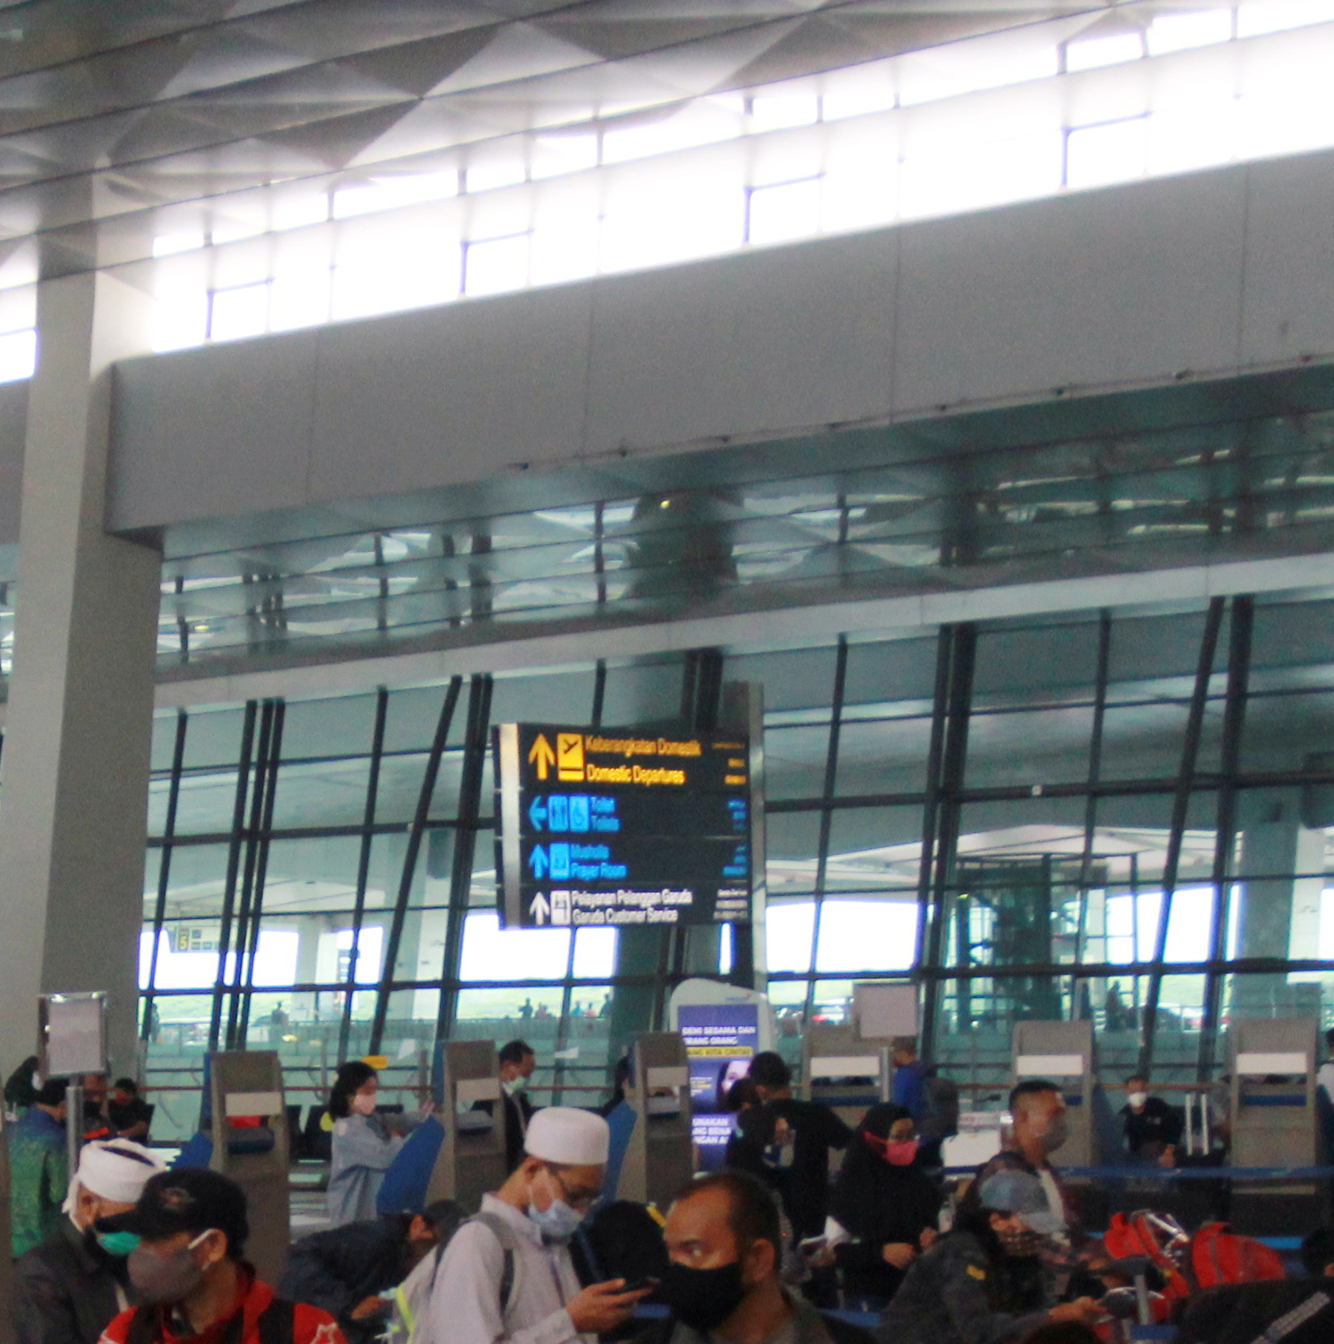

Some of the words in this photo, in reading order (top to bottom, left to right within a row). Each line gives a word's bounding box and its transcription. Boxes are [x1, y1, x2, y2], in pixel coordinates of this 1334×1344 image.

[586, 763, 632, 783] Domestic
[633, 765, 686, 787] Departures
[662, 888, 693, 905] Garuda
[572, 908, 605, 925] Garuda
[605, 908, 647, 924] Customer
[647, 907, 679, 923] Service
